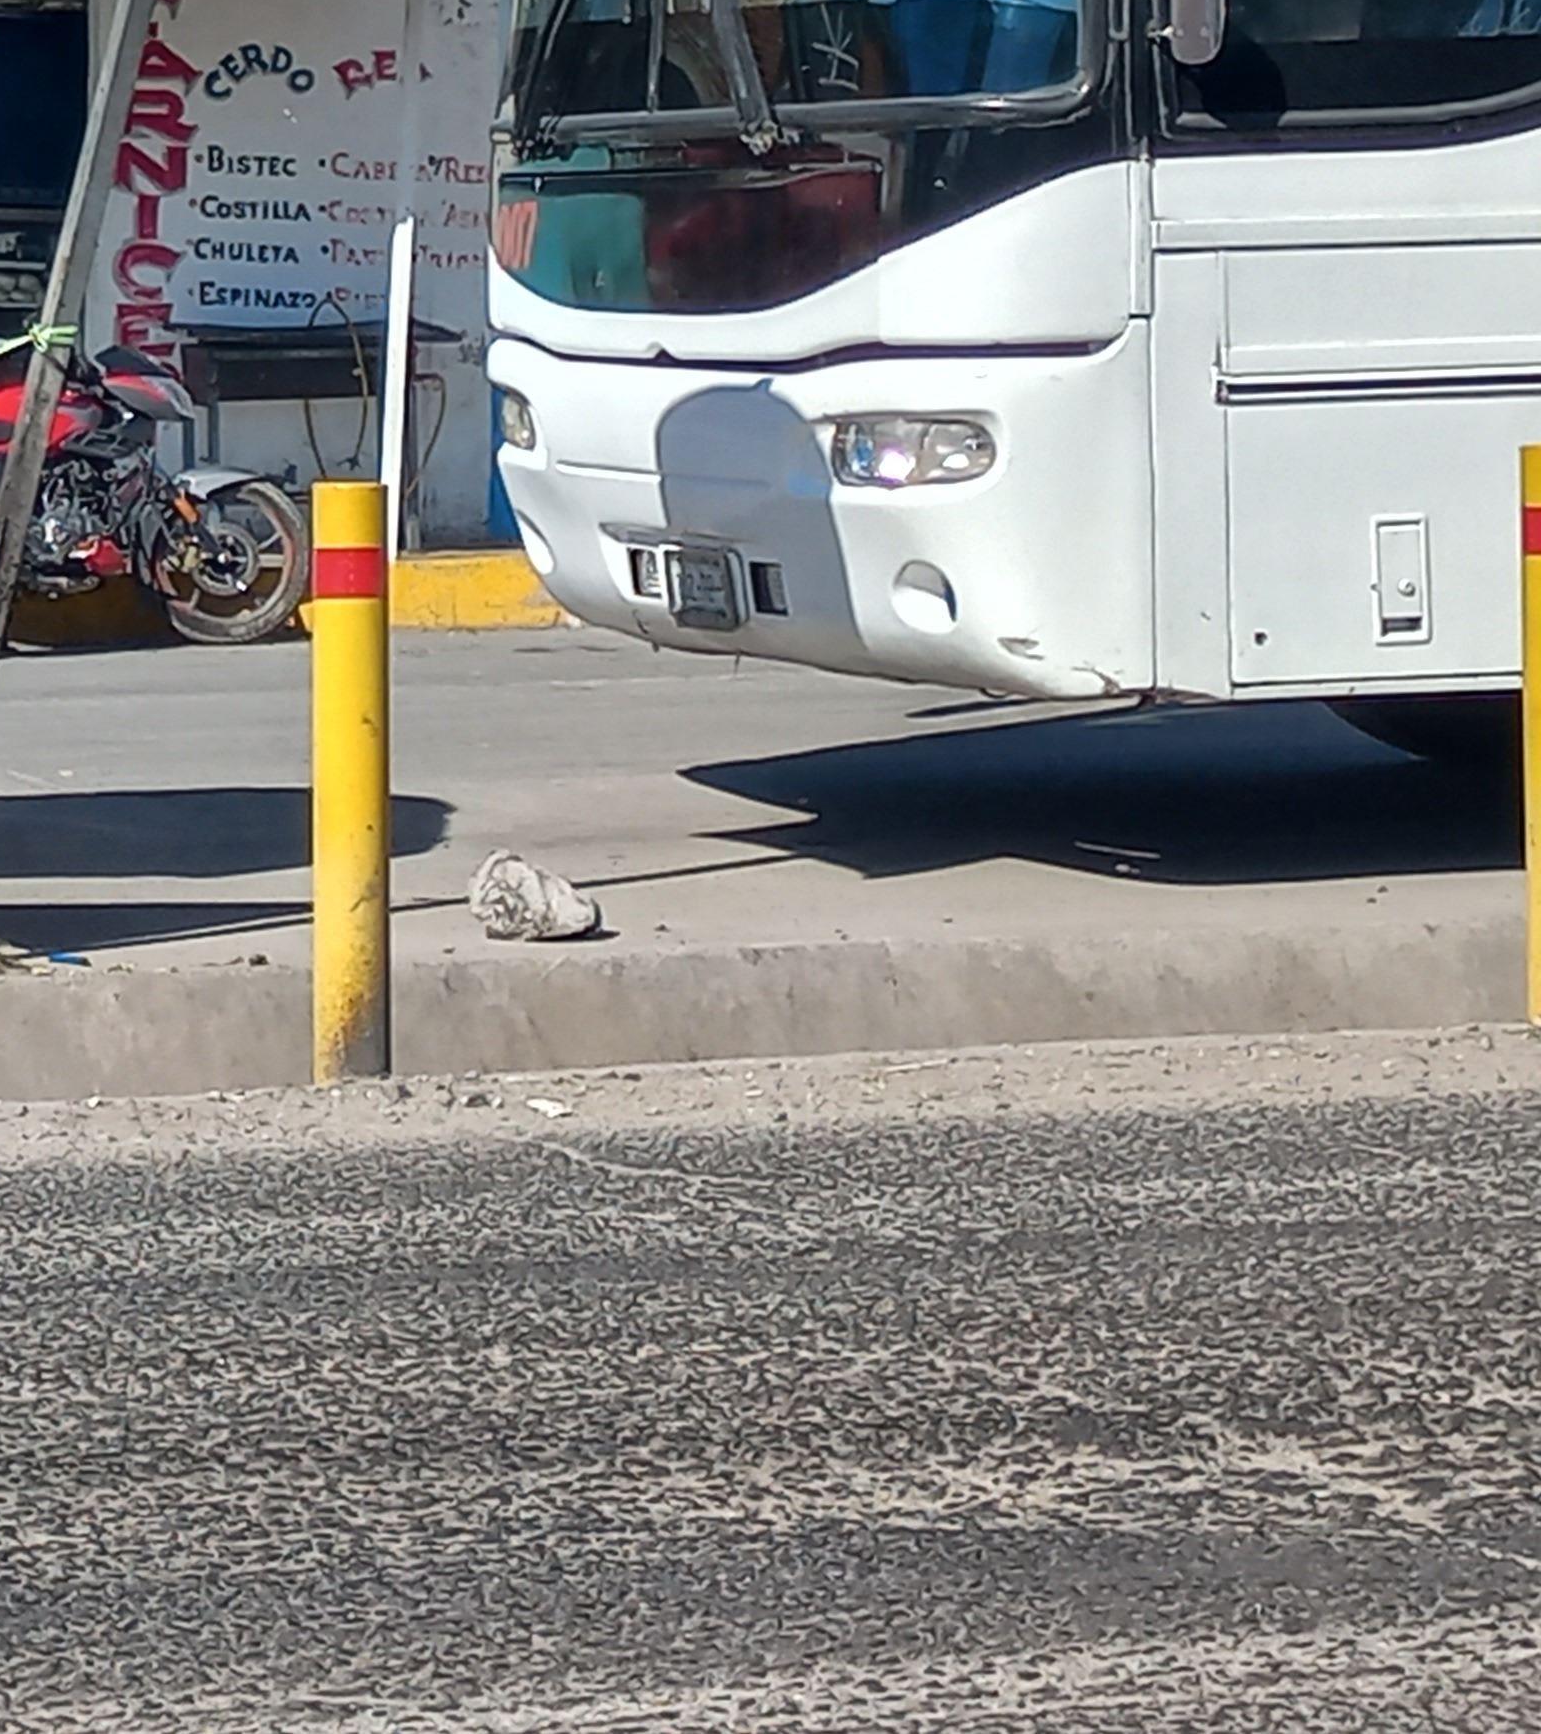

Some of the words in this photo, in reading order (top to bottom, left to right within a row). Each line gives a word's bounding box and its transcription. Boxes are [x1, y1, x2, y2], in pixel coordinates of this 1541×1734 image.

[203, 43, 315, 99] CERDO
[206, 145, 296, 177] BISTEC
[200, 194, 312, 222] COSTILLA
[194, 237, 299, 264] CHULETA
[199, 281, 317, 309] ESPINAZO
